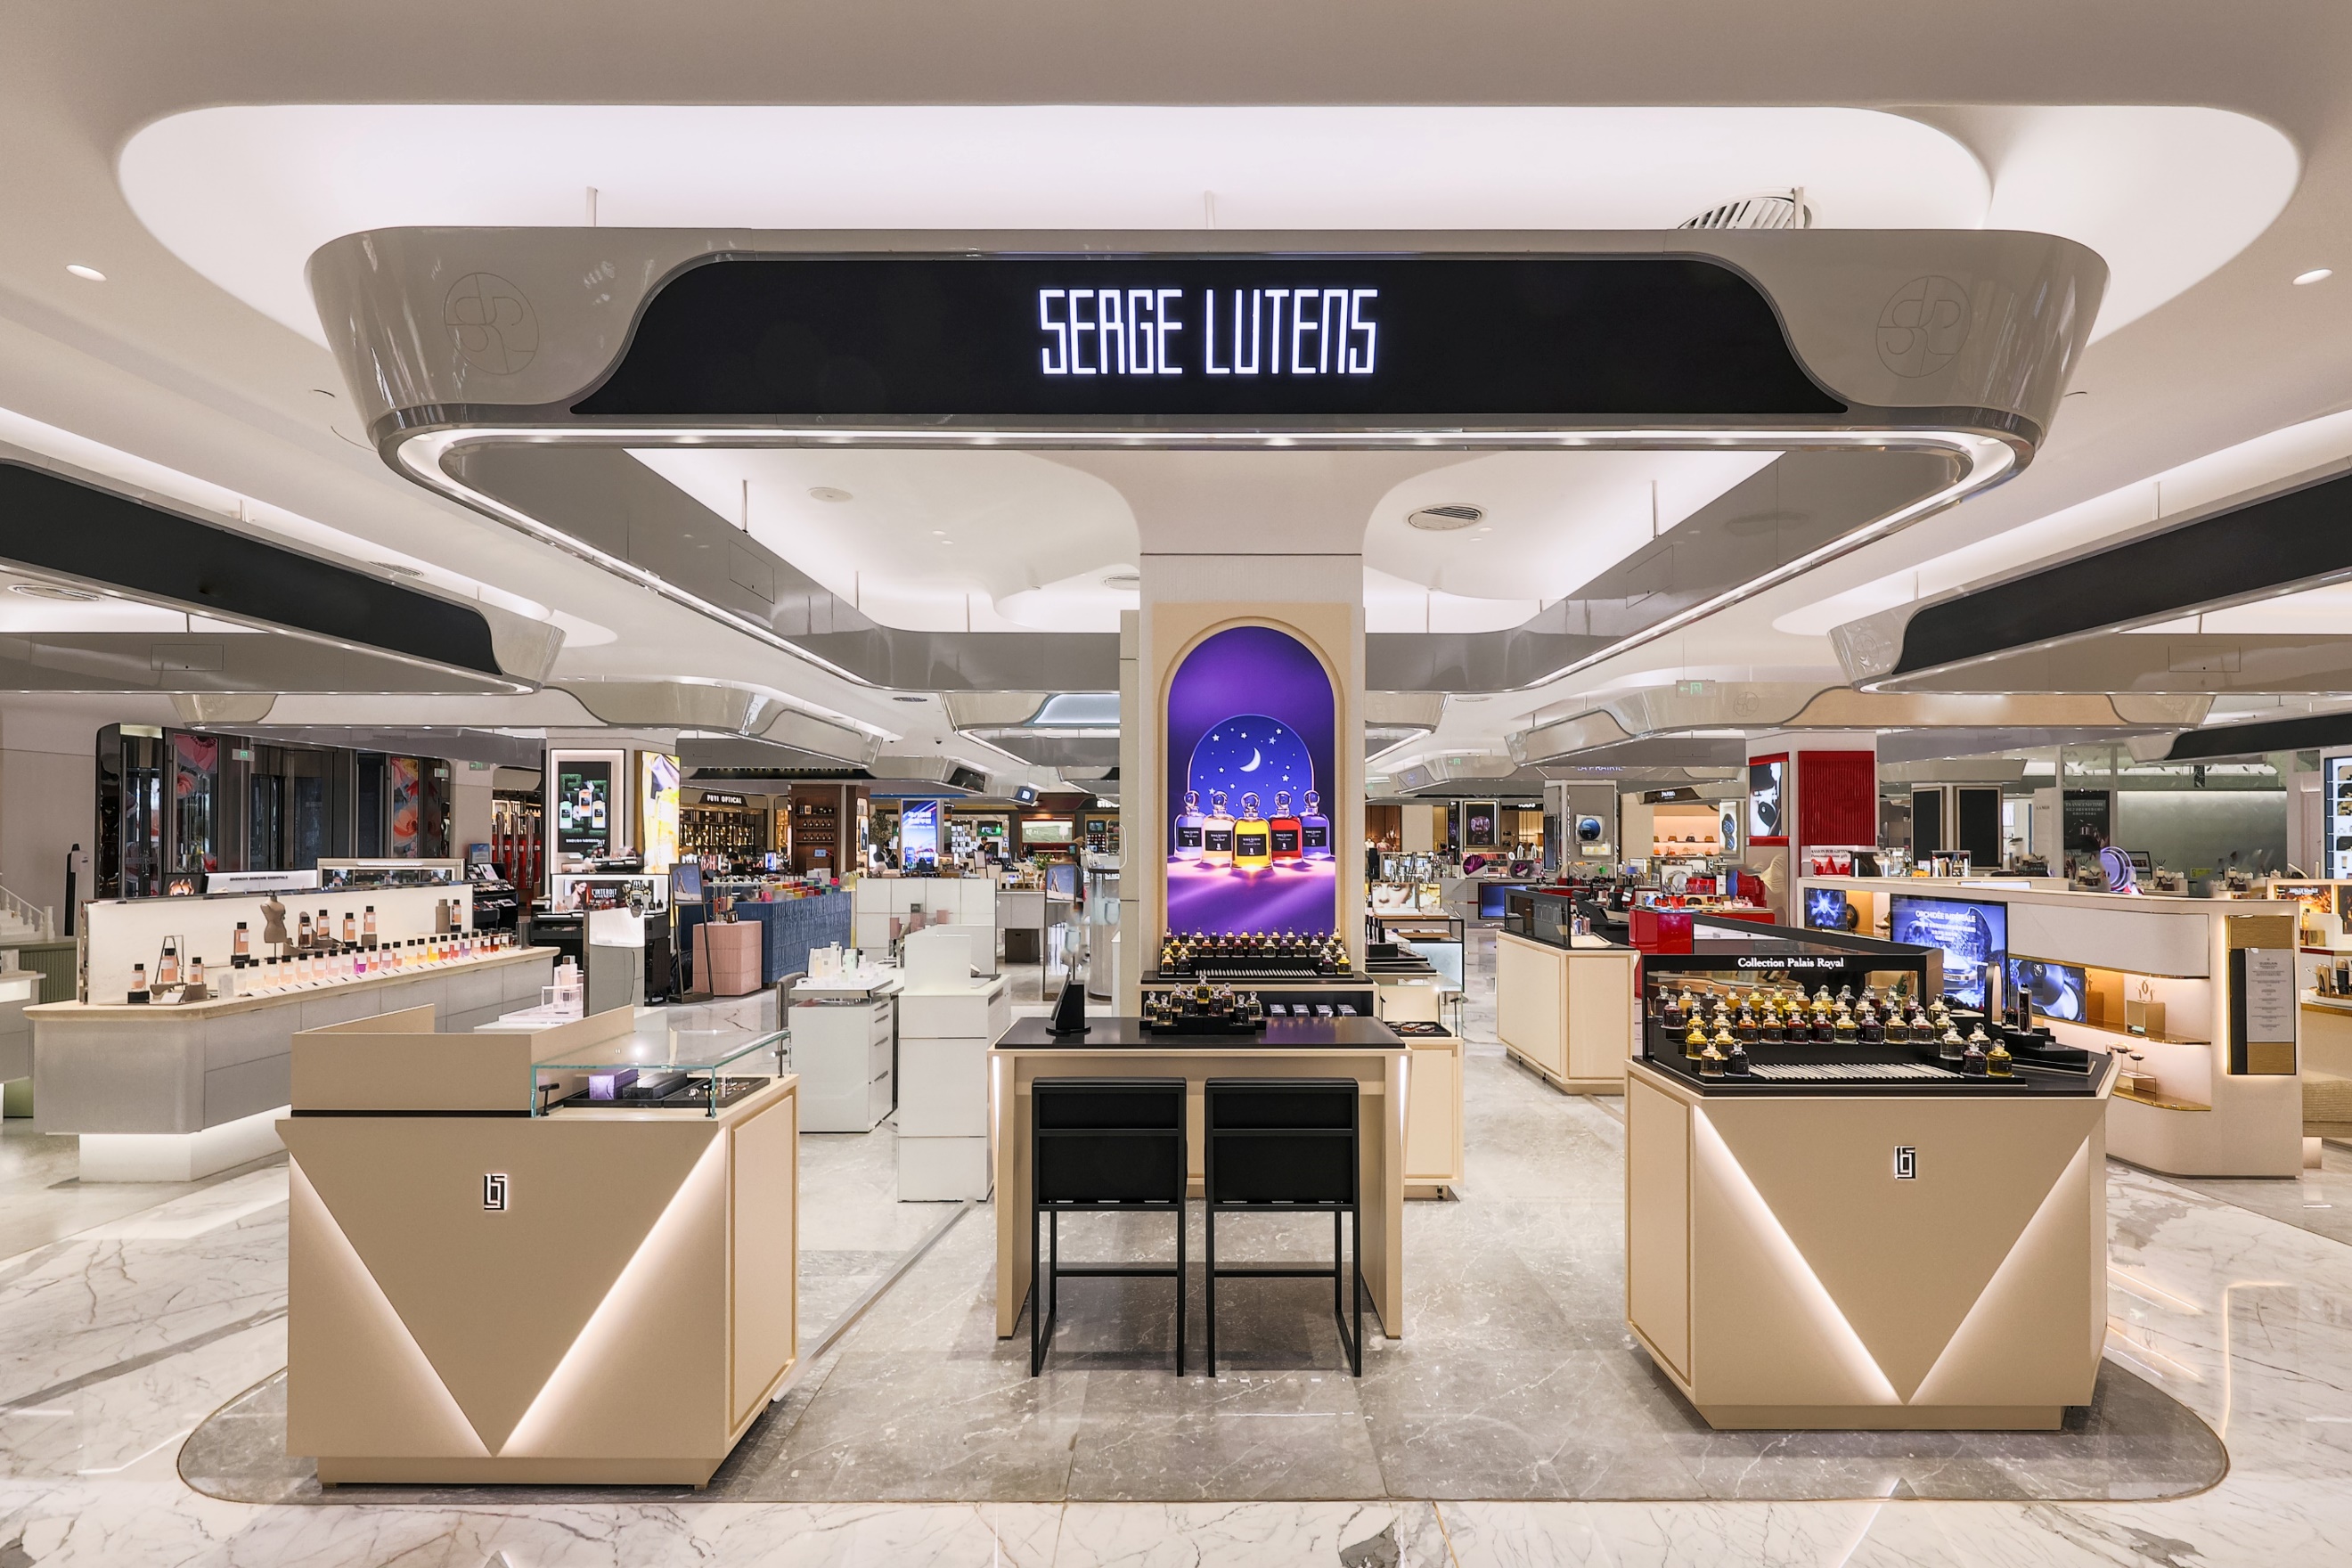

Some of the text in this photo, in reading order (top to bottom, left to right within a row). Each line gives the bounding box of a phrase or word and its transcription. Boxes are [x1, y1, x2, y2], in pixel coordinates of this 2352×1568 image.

[1039, 288, 1379, 375] SERGE LUTENS
[722, 796, 742, 804] OPTICAL
[1915, 911, 1945, 920] ORCHIDÉE
[1737, 957, 1844, 969] Collection Palais Royal
